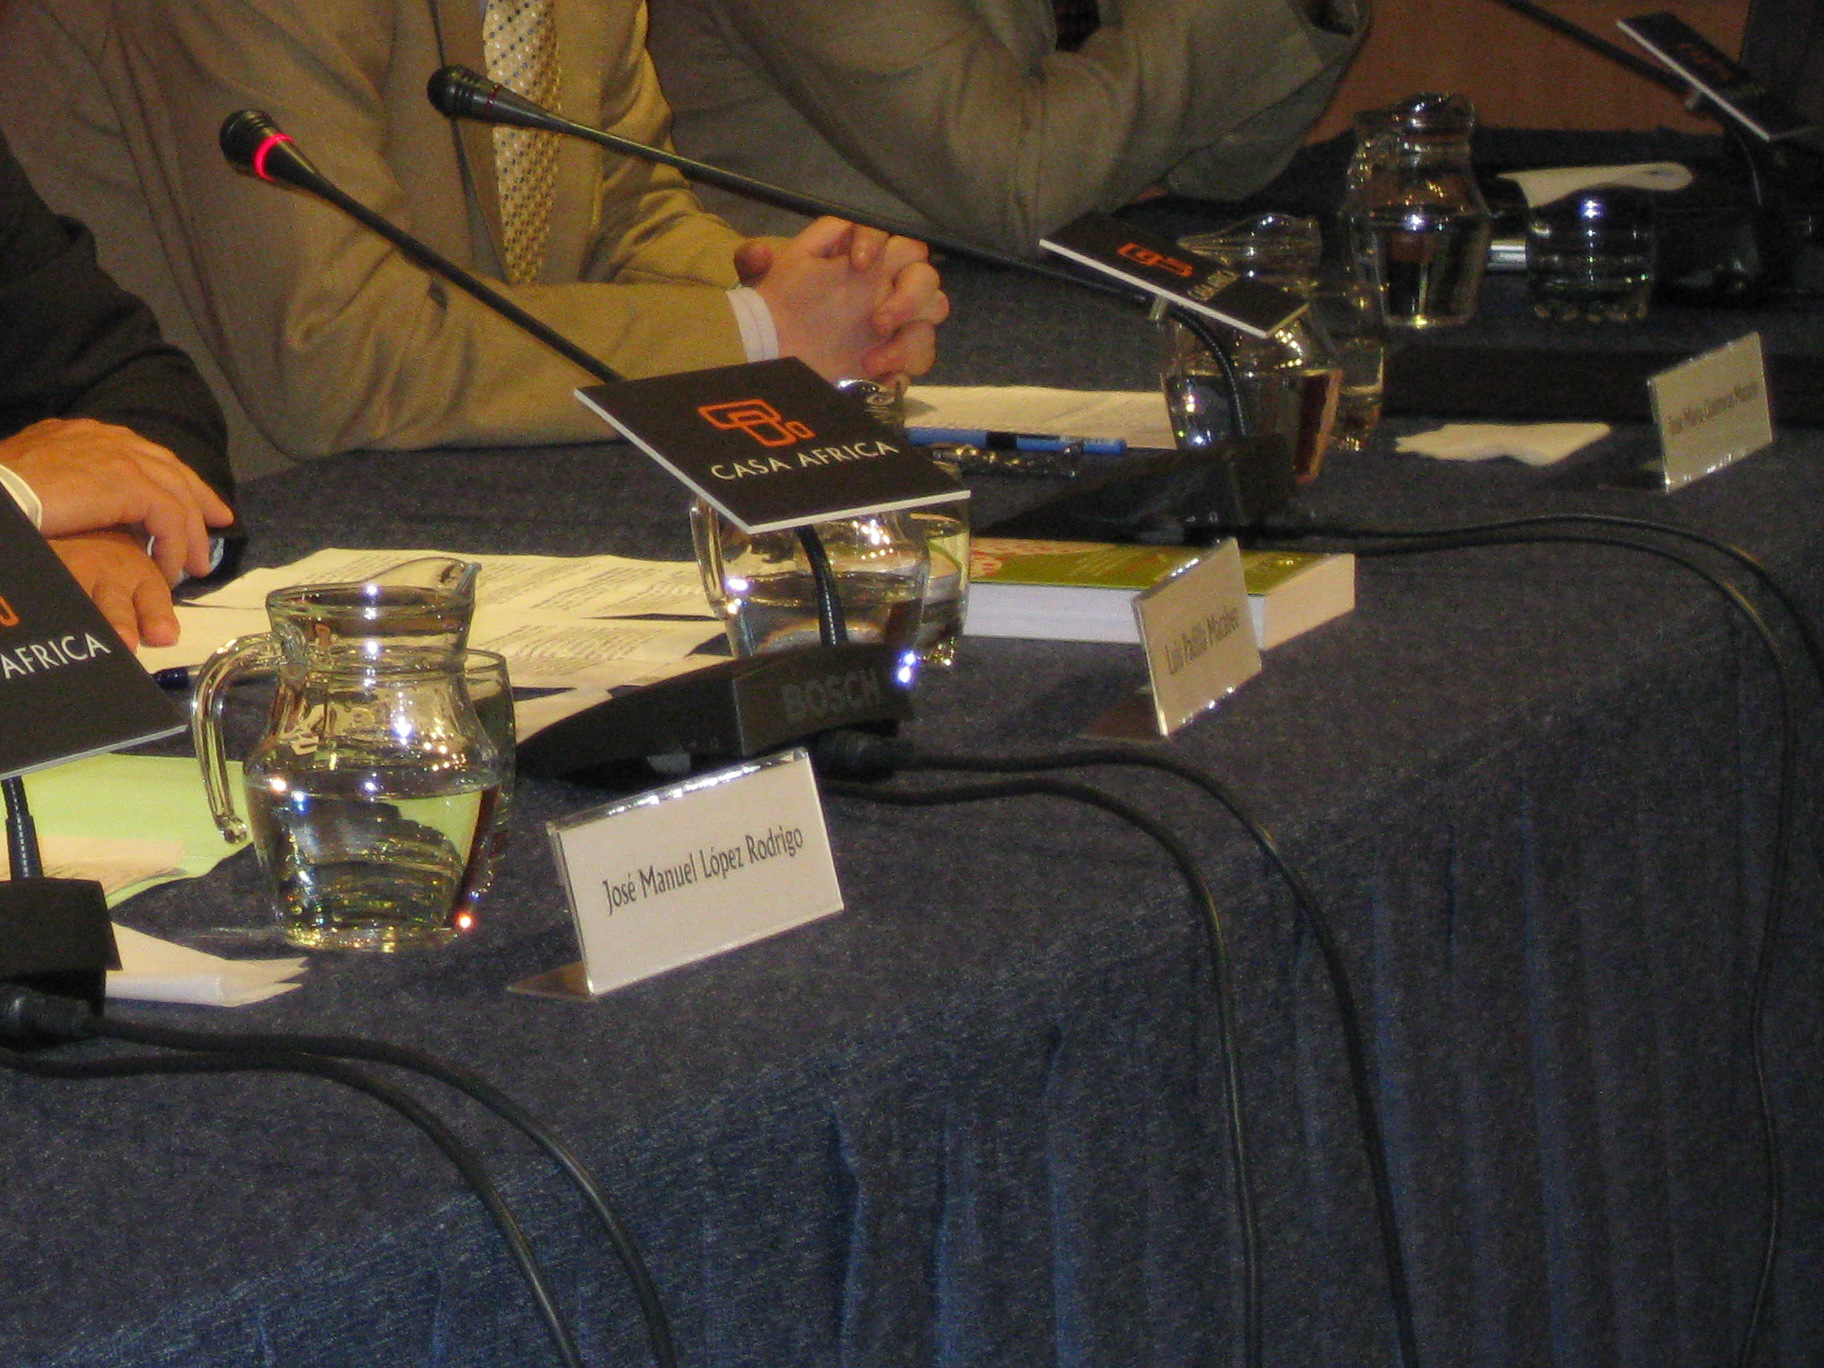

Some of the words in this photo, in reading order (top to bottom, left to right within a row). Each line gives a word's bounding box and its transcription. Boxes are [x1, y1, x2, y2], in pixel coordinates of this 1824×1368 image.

[710, 456, 792, 481] CASA
[797, 440, 900, 468] AFRICA
[0, 632, 112, 680] AFRICA
[601, 873, 638, 916] José
[638, 853, 699, 898] Manuel
[699, 846, 745, 880] López
[745, 825, 804, 865] Rodrigo
